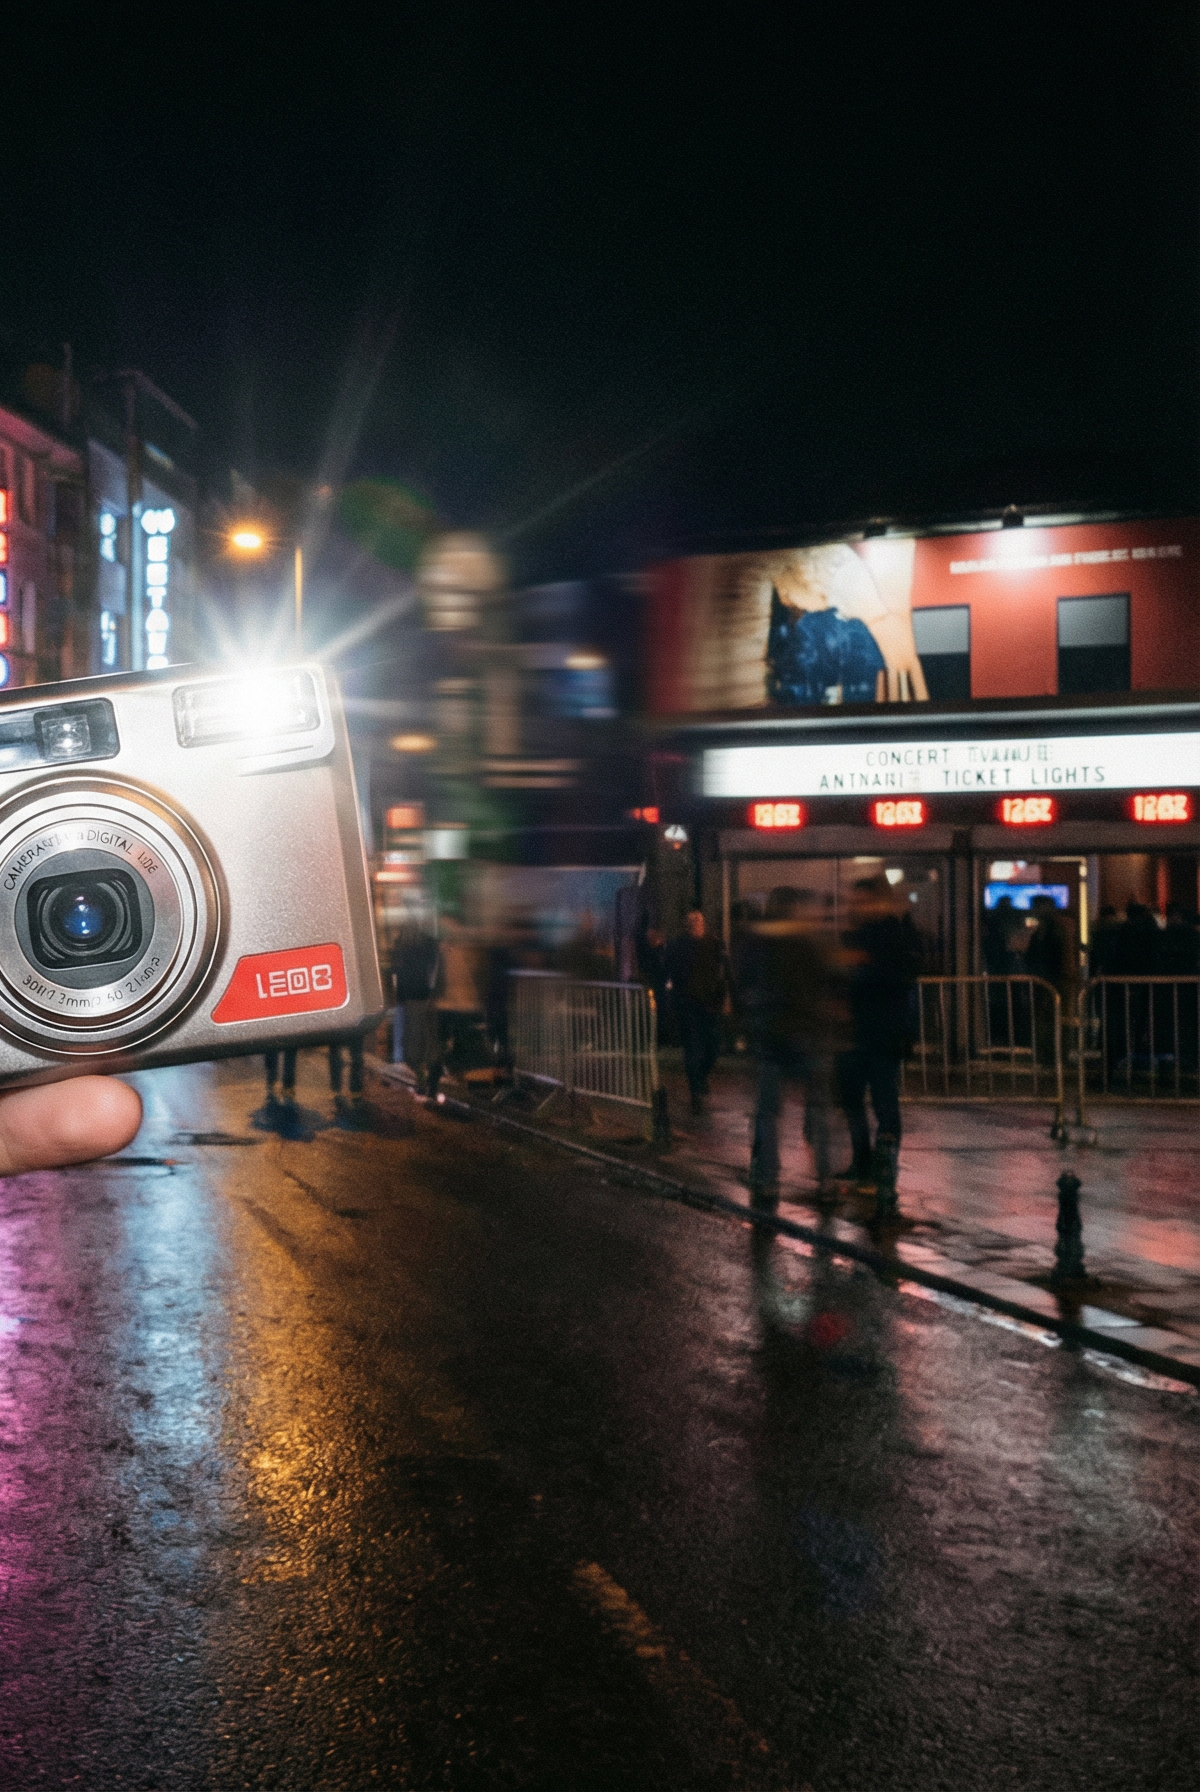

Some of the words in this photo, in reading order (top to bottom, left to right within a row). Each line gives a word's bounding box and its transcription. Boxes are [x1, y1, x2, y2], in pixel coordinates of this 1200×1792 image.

[866, 747, 950, 768] CONCERT
[943, 768, 1012, 786] TICKET
[1031, 765, 1106, 784] LIGHTS
[86, 828, 134, 856] DIGITAL
